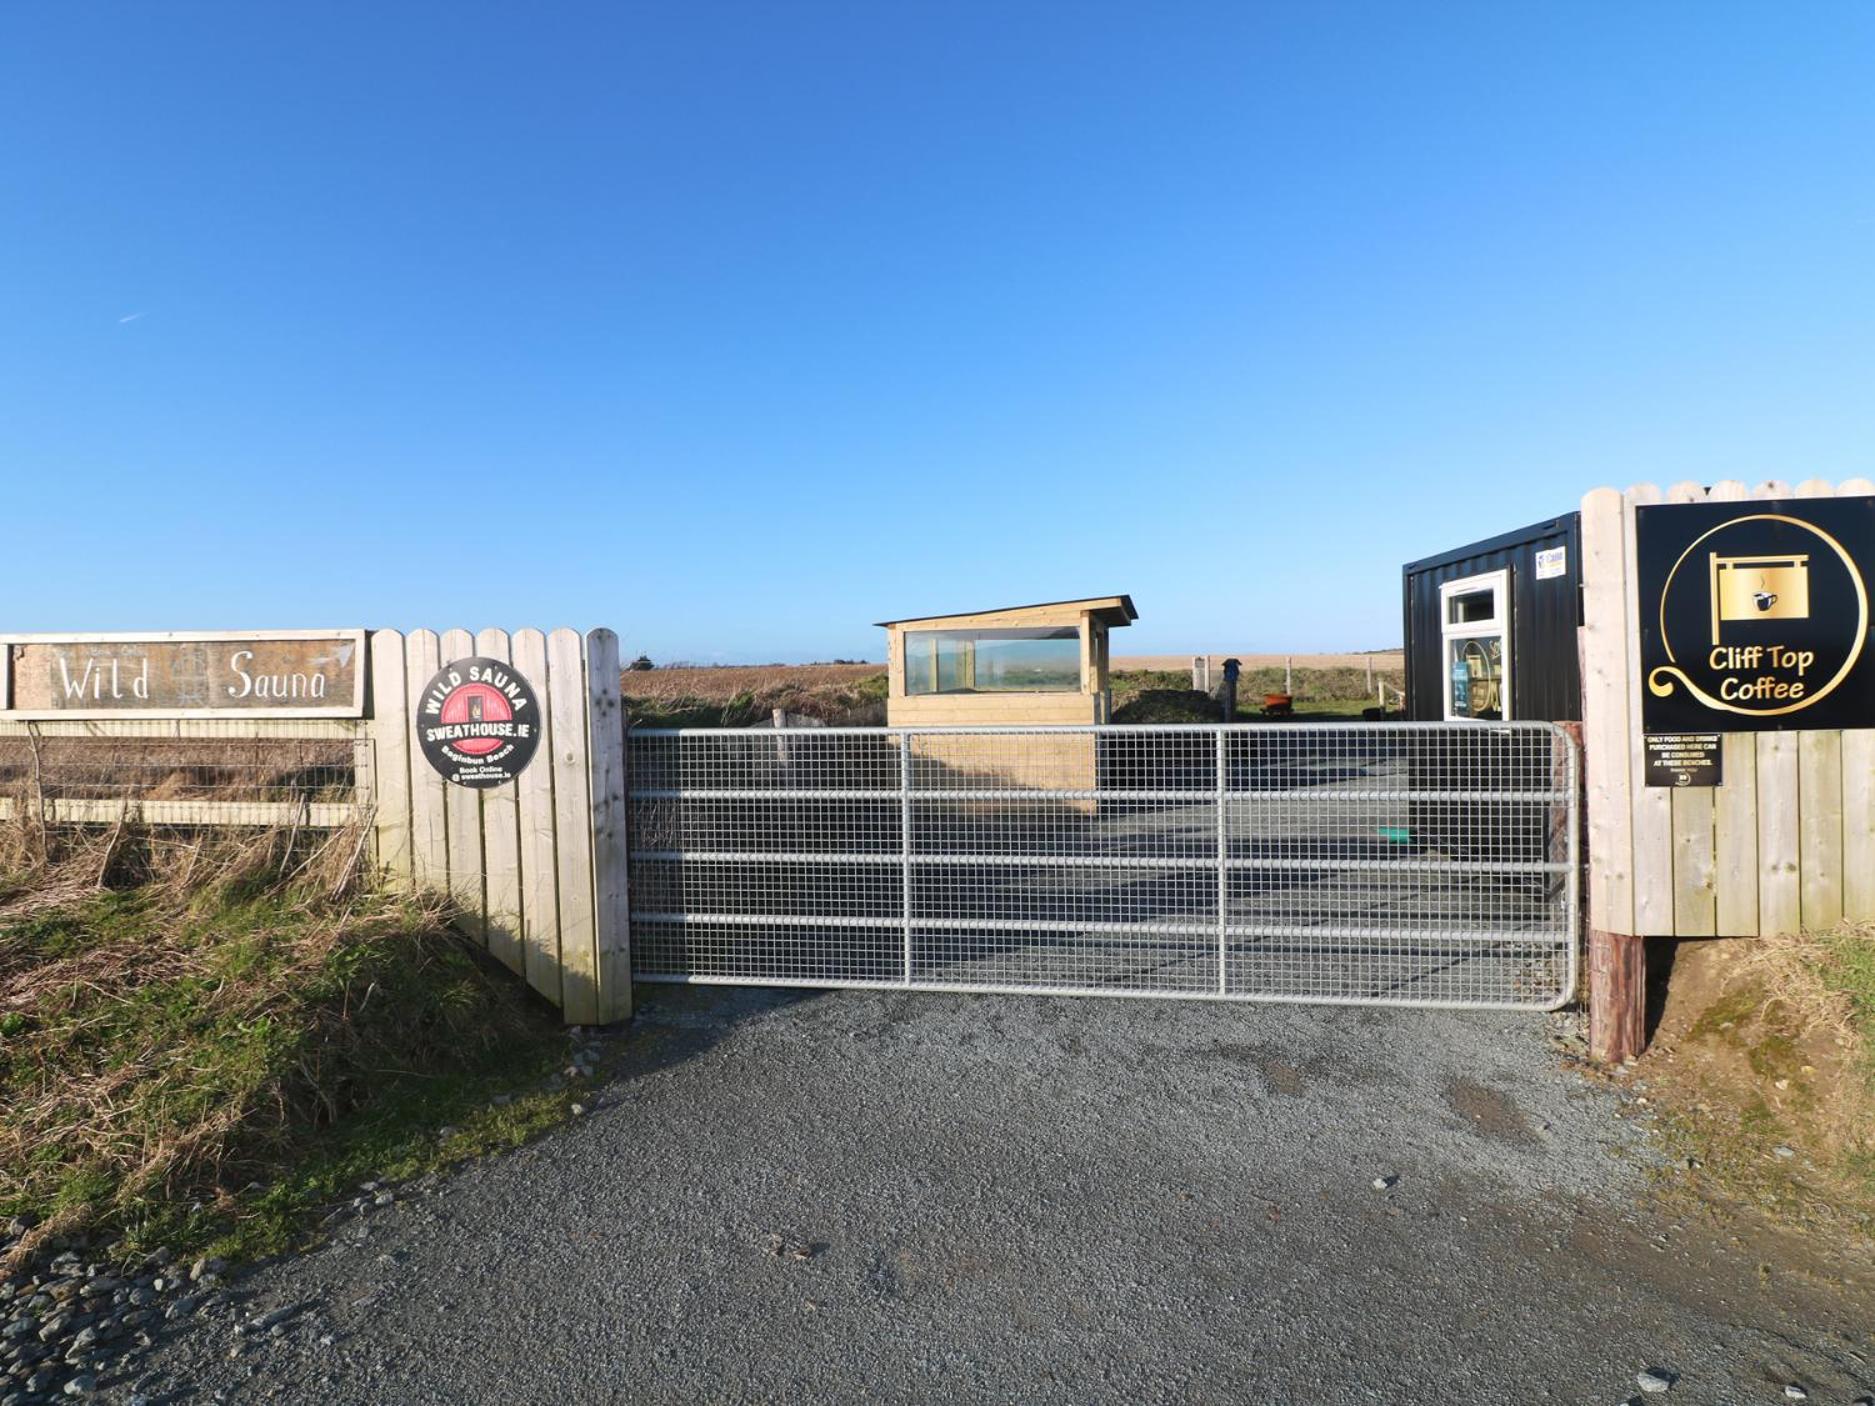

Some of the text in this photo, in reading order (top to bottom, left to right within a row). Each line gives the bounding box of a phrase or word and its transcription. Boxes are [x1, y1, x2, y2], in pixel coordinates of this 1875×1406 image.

[1709, 645, 1814, 676] Cliff Top
[60, 650, 325, 700] Wild Sauna
[1720, 676, 1804, 701] Coffee
[425, 666, 528, 715] WILD SAUNA
[426, 723, 530, 742] SWEATHOUSE.IE
[486, 744, 515, 763] Beach
